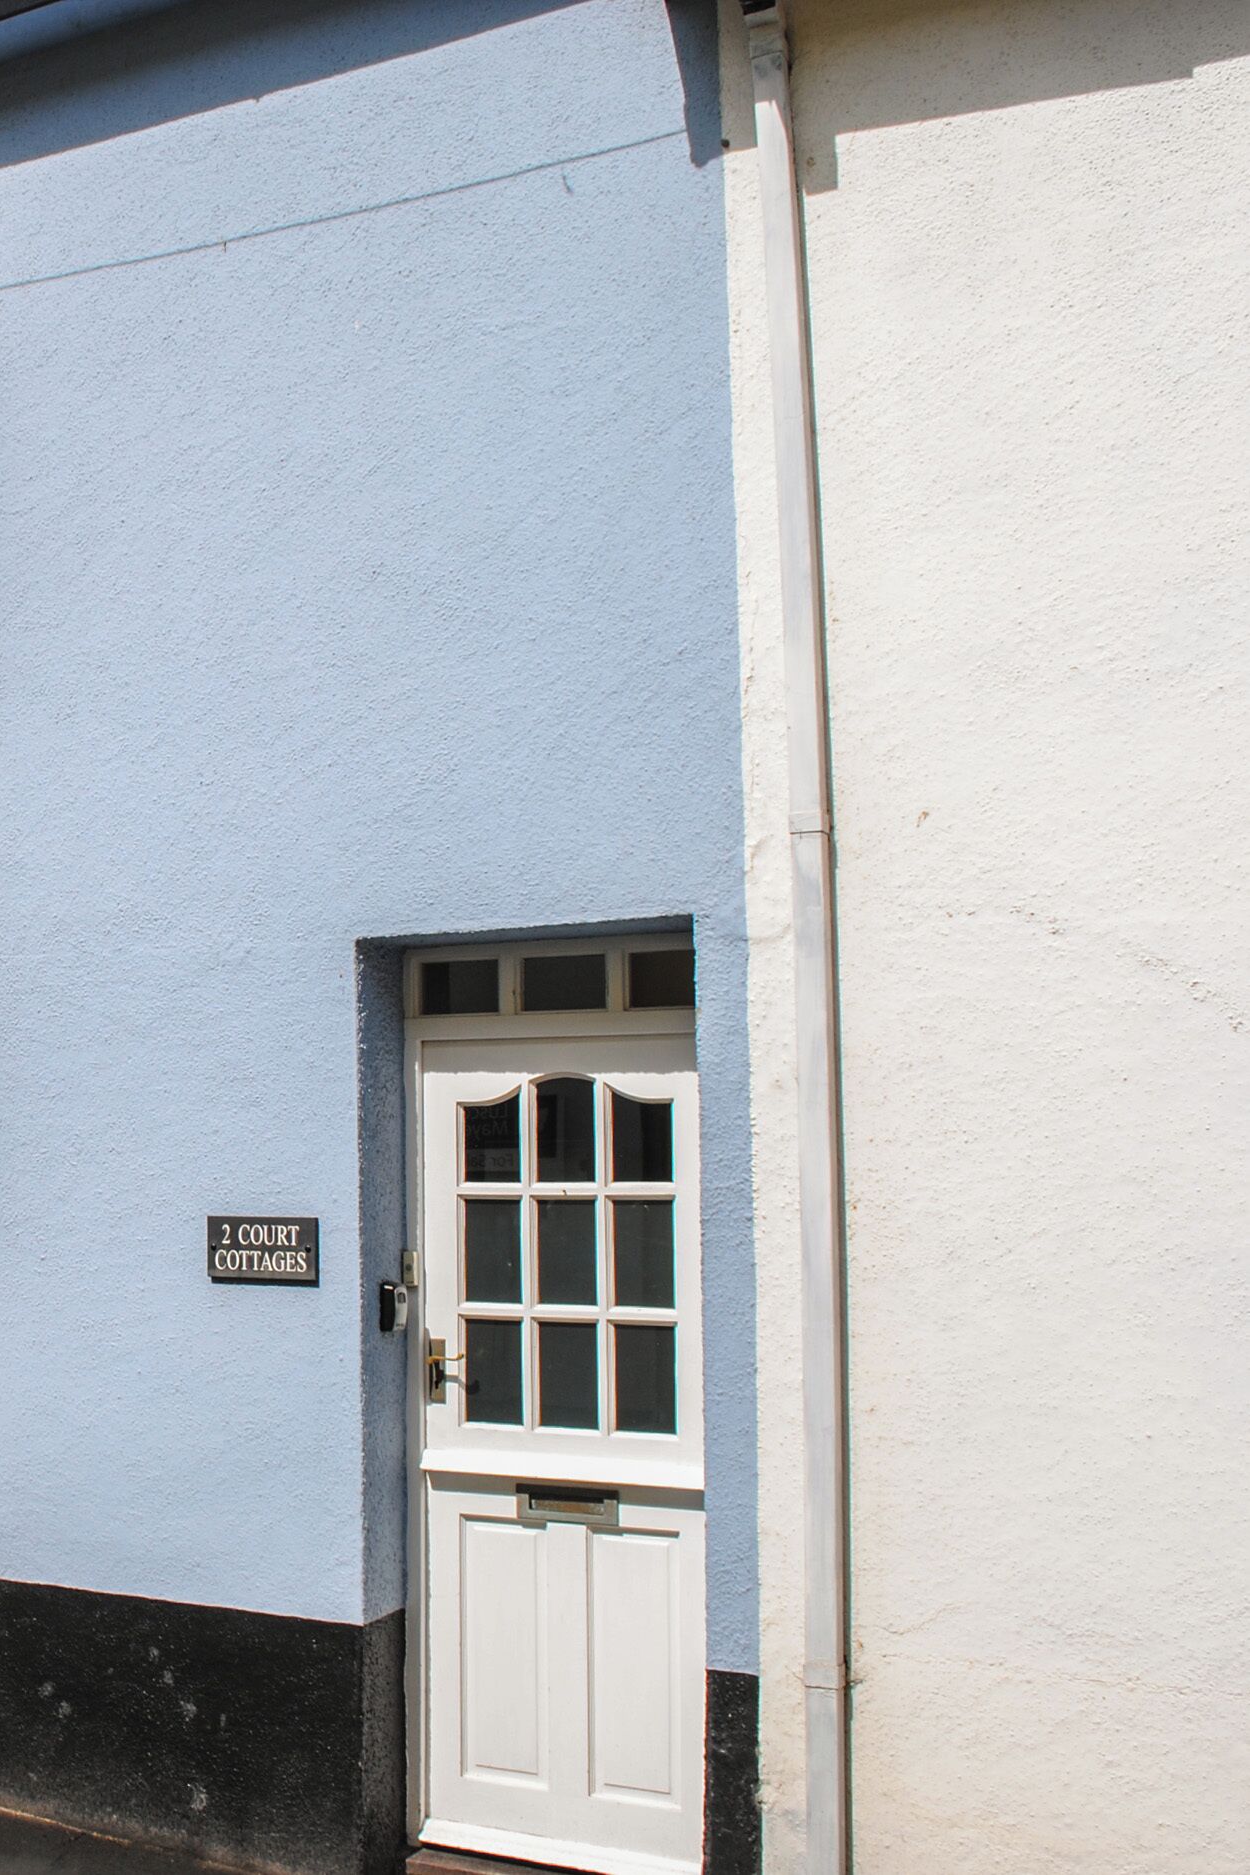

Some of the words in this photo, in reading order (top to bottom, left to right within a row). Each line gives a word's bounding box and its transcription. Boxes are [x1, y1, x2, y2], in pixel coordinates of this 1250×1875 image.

[221, 1223, 231, 1244] 2
[238, 1224, 300, 1246] COURT
[214, 1249, 307, 1273] COTTAGES
